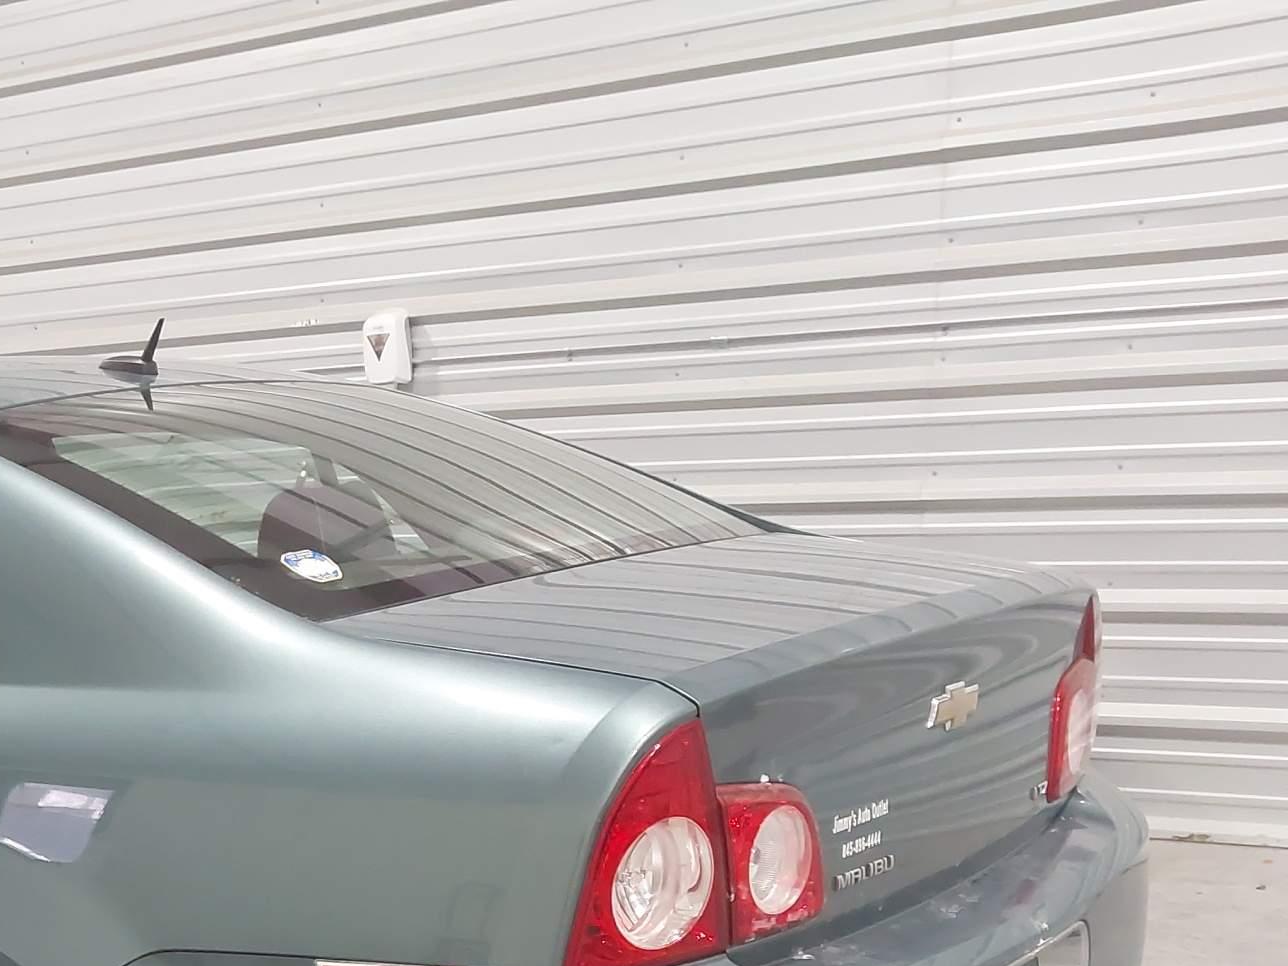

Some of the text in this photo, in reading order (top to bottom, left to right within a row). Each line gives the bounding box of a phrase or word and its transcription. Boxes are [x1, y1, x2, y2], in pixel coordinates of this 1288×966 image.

[857, 806, 871, 825] Auto
[872, 798, 889, 819] Outlet
[833, 854, 894, 891] MALIBU
